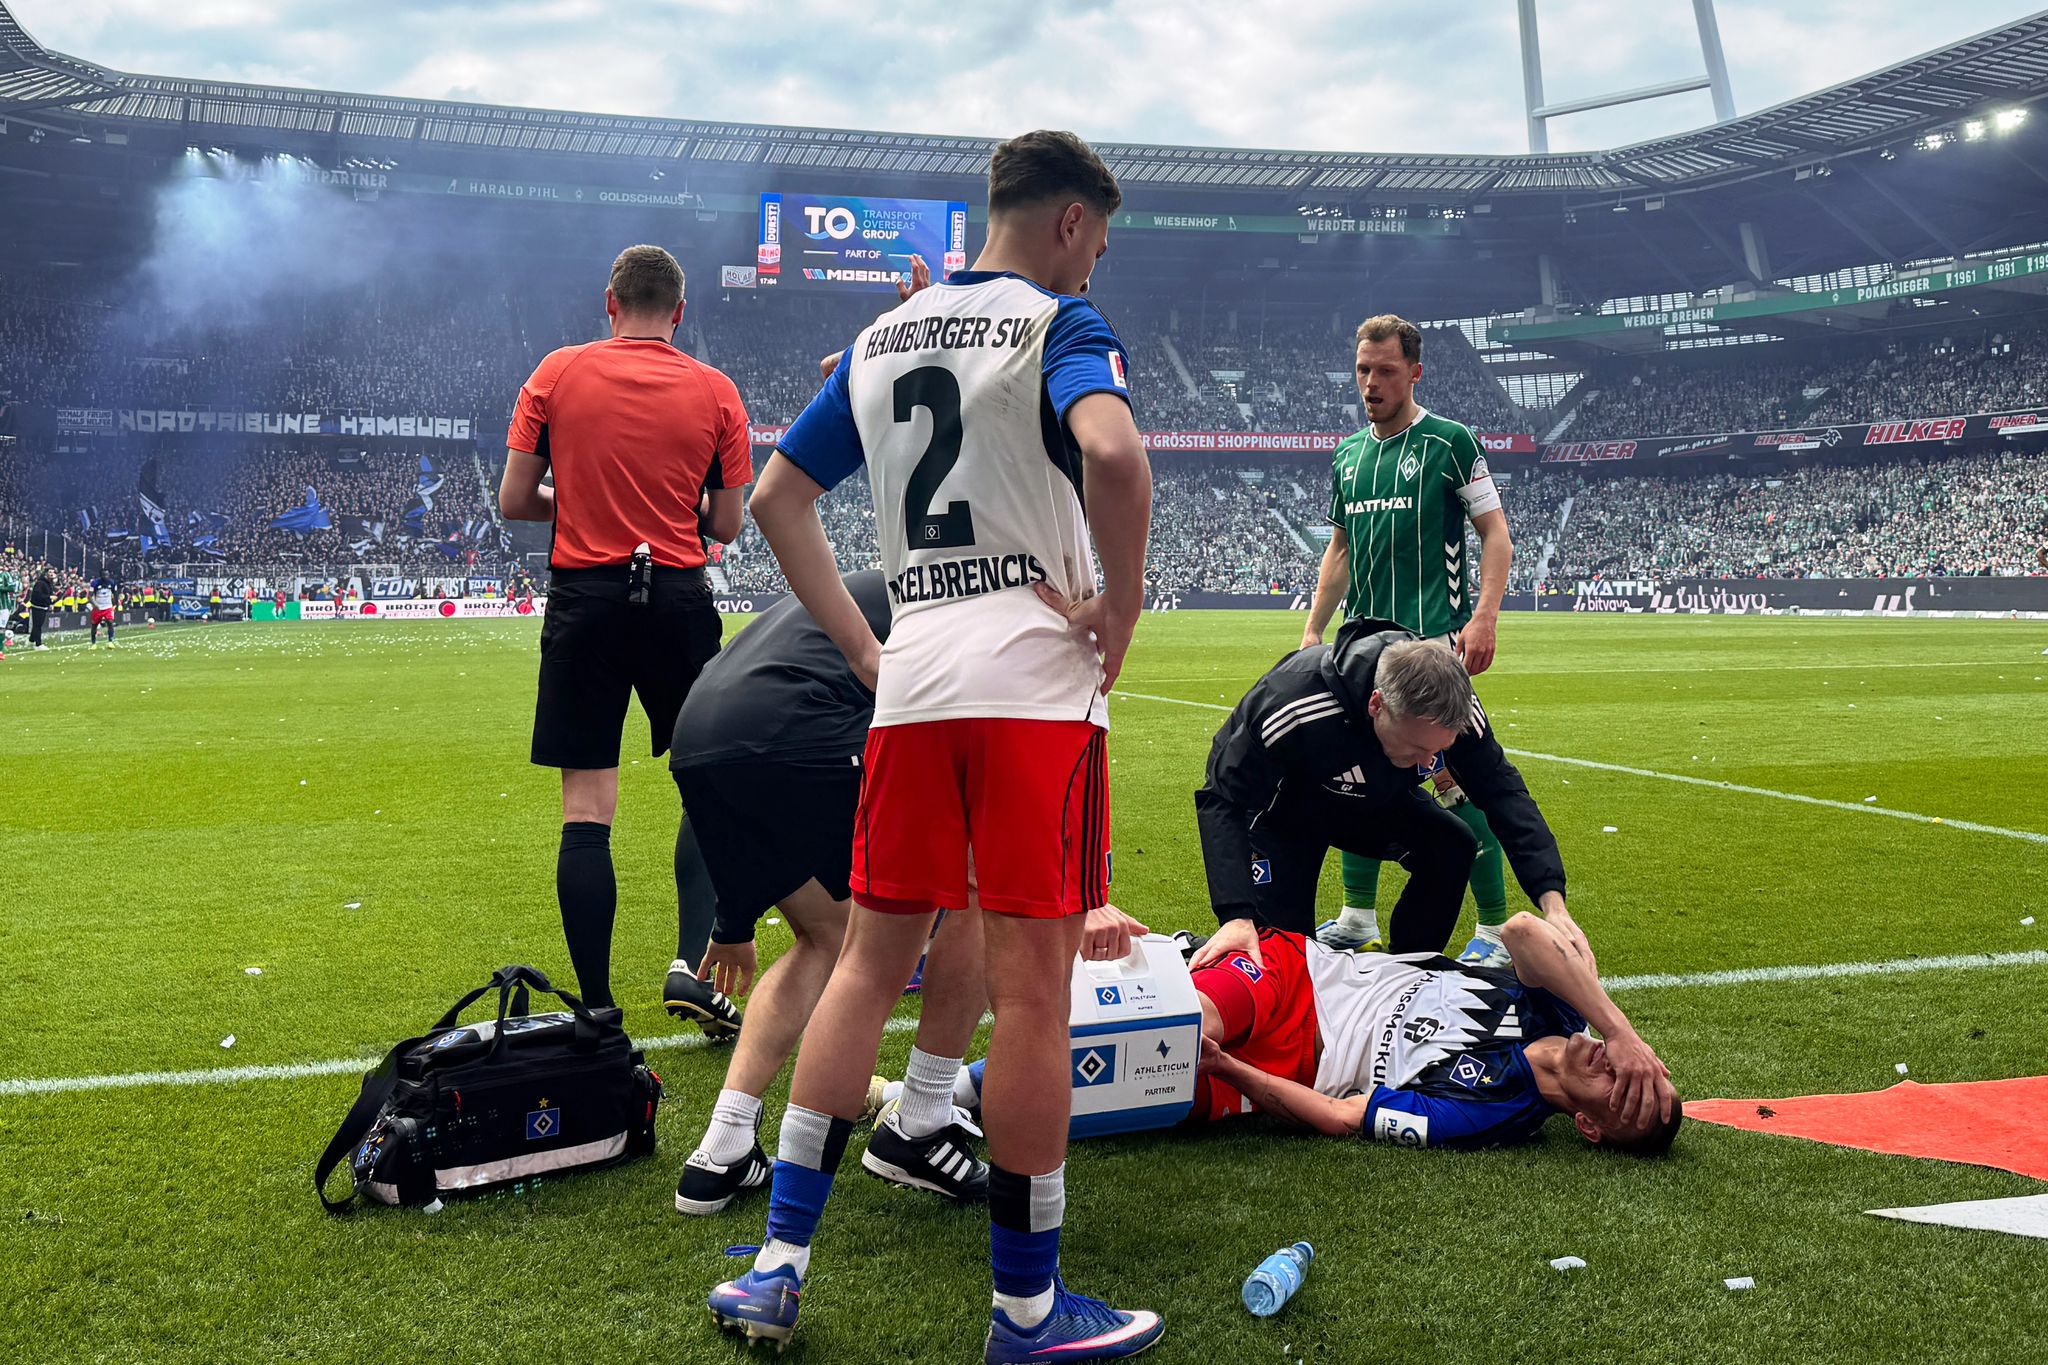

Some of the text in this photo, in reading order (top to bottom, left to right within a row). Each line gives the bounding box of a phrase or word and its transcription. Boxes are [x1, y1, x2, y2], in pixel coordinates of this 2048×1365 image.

[470, 182, 560, 198] HARALD PIHL
[599, 191, 685, 206] GOLDSCHMAUS
[804, 206, 856, 240] TO
[863, 209, 922, 221] TRANSPORT
[1153, 215, 1218, 228] WIESENHOF
[863, 219, 916, 231] OVERSEAS
[1307, 219, 1406, 233] WERDER BREMEN
[862, 229, 899, 240] GROUP
[845, 249, 881, 259] PART OF
[1857, 277, 1930, 301] POKALSIEGER
[1953, 270, 1976, 285] 1961
[1994, 262, 2016, 278] 1991
[1623, 306, 1714, 328] WERDER BREMEN
[864, 316, 991, 361] HAMBURGER
[118, 409, 471, 440] NORDTRIBUNE HAMBURG
[1988, 413, 2038, 429] HILKER
[1754, 433, 1806, 446] HILKER
[1863, 418, 1966, 446] HILKER
[1153, 432, 1215, 448] GRÖSSTEN
[1217, 435, 1311, 449] SHOPPINGWELT
[1313, 436, 1336, 449] DES
[893, 365, 976, 551] 2
[1540, 441, 1638, 462] HILKER
[1134, 1061, 1190, 1076] ATHLETICUM
[1144, 1085, 1176, 1097] PARTNER
